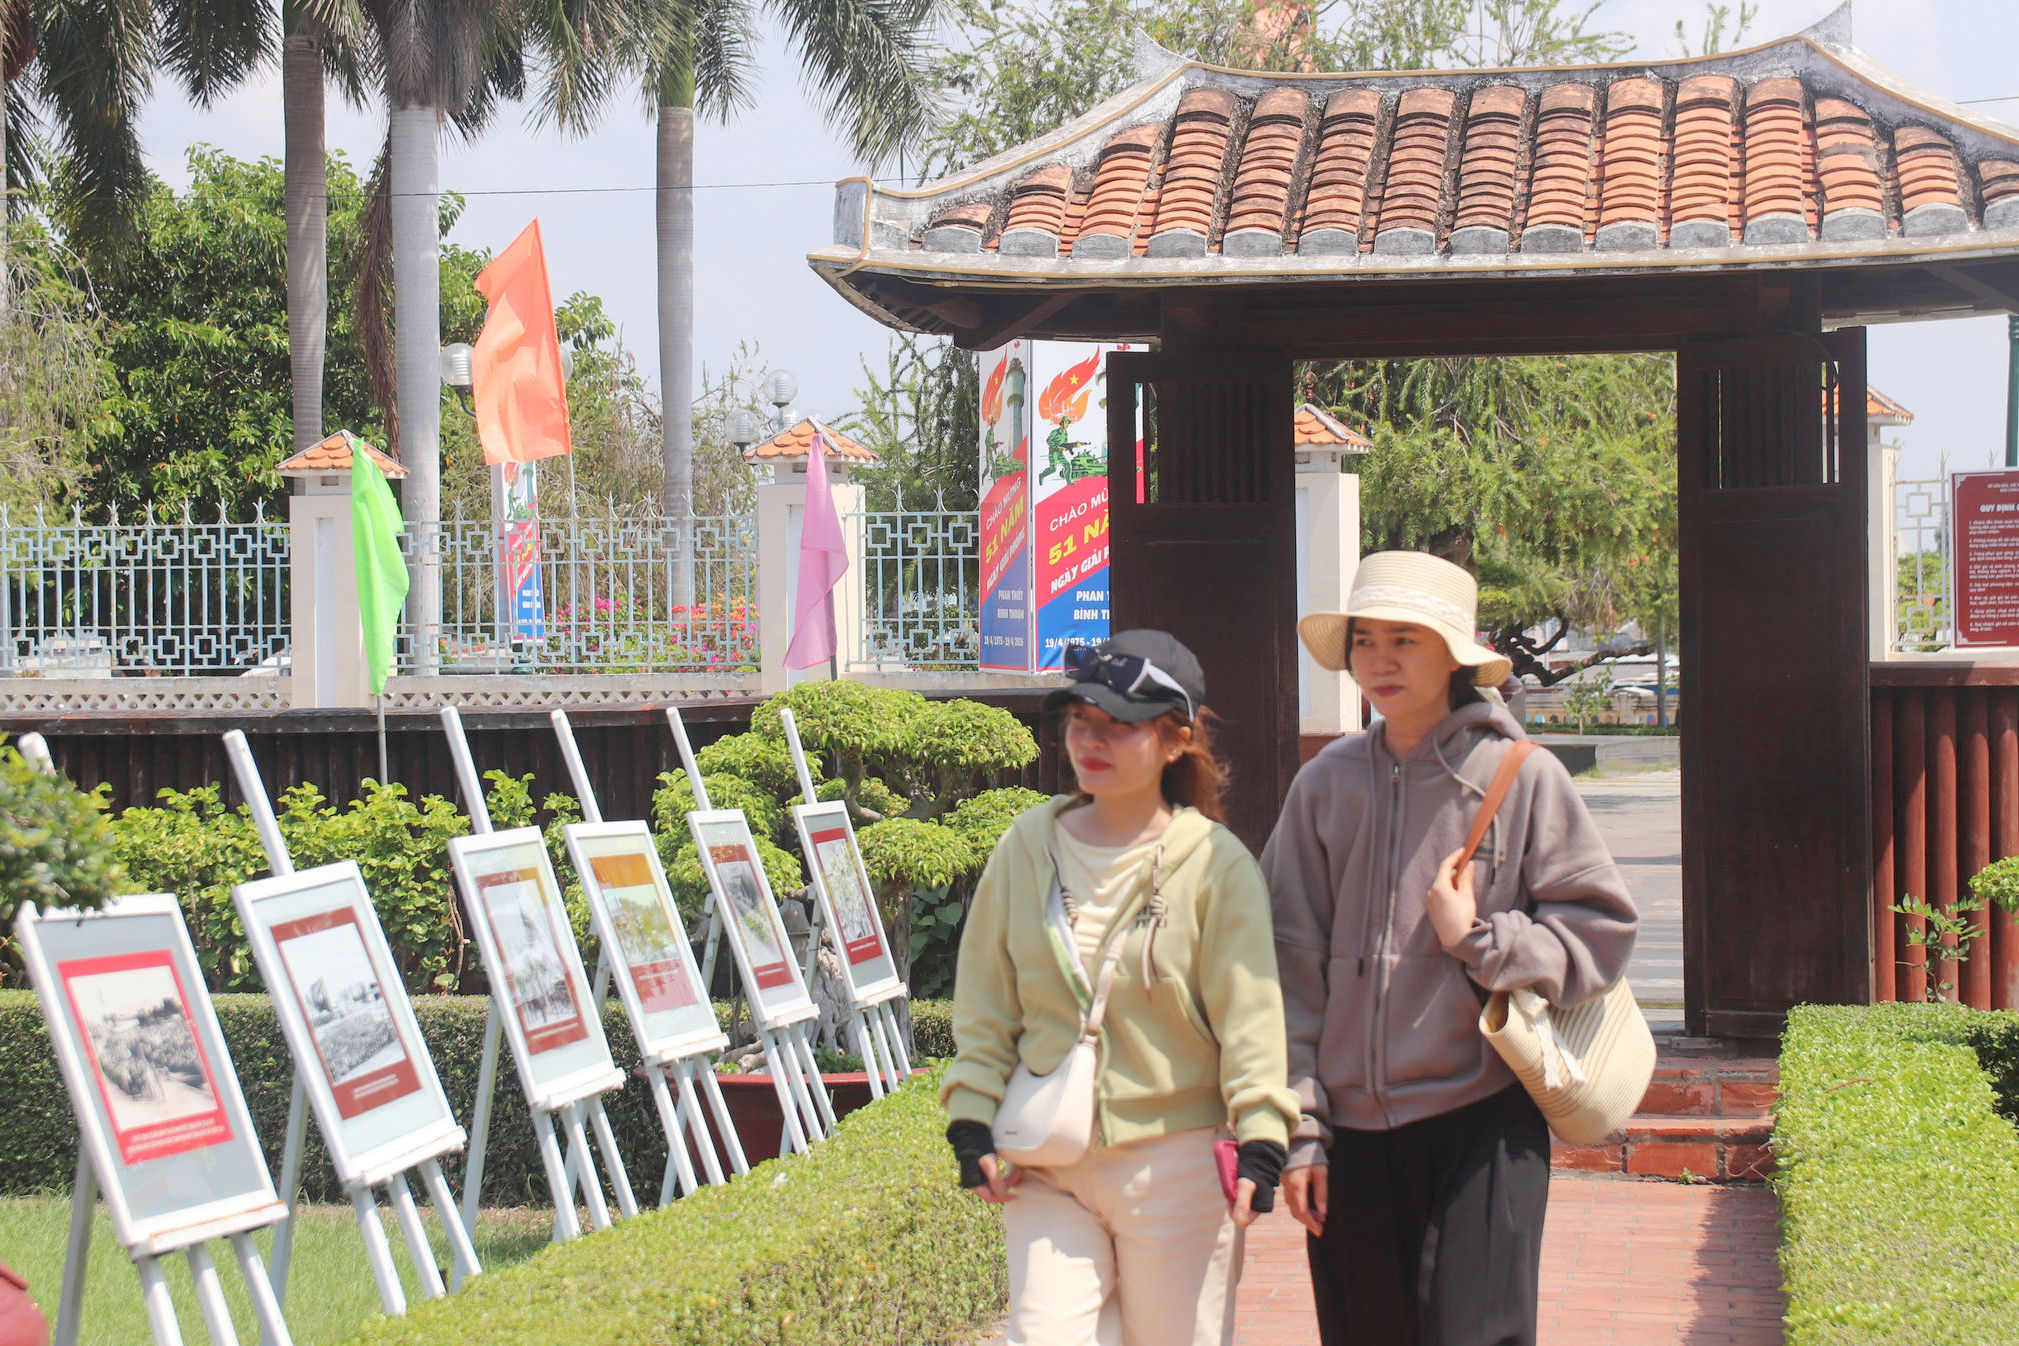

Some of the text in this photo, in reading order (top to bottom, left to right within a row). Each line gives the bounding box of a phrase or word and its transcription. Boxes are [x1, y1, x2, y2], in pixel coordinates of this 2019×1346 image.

[986, 502, 1003, 531] CHÀO
[1049, 487, 1109, 531] CHÀO MỪ
[1980, 504, 1995, 513] QUY
[1996, 503, 2015, 514] ĐỊNH
[985, 495, 1024, 564] 51 NĂM
[1048, 535, 1077, 565] 51
[1083, 509, 1109, 544] NĂ
[1050, 564, 1078, 594] NGÀY
[1080, 549, 1102, 573] GIẢI
[1073, 607, 1099, 620] BÌNH
[1076, 590, 1104, 602] PHAN
